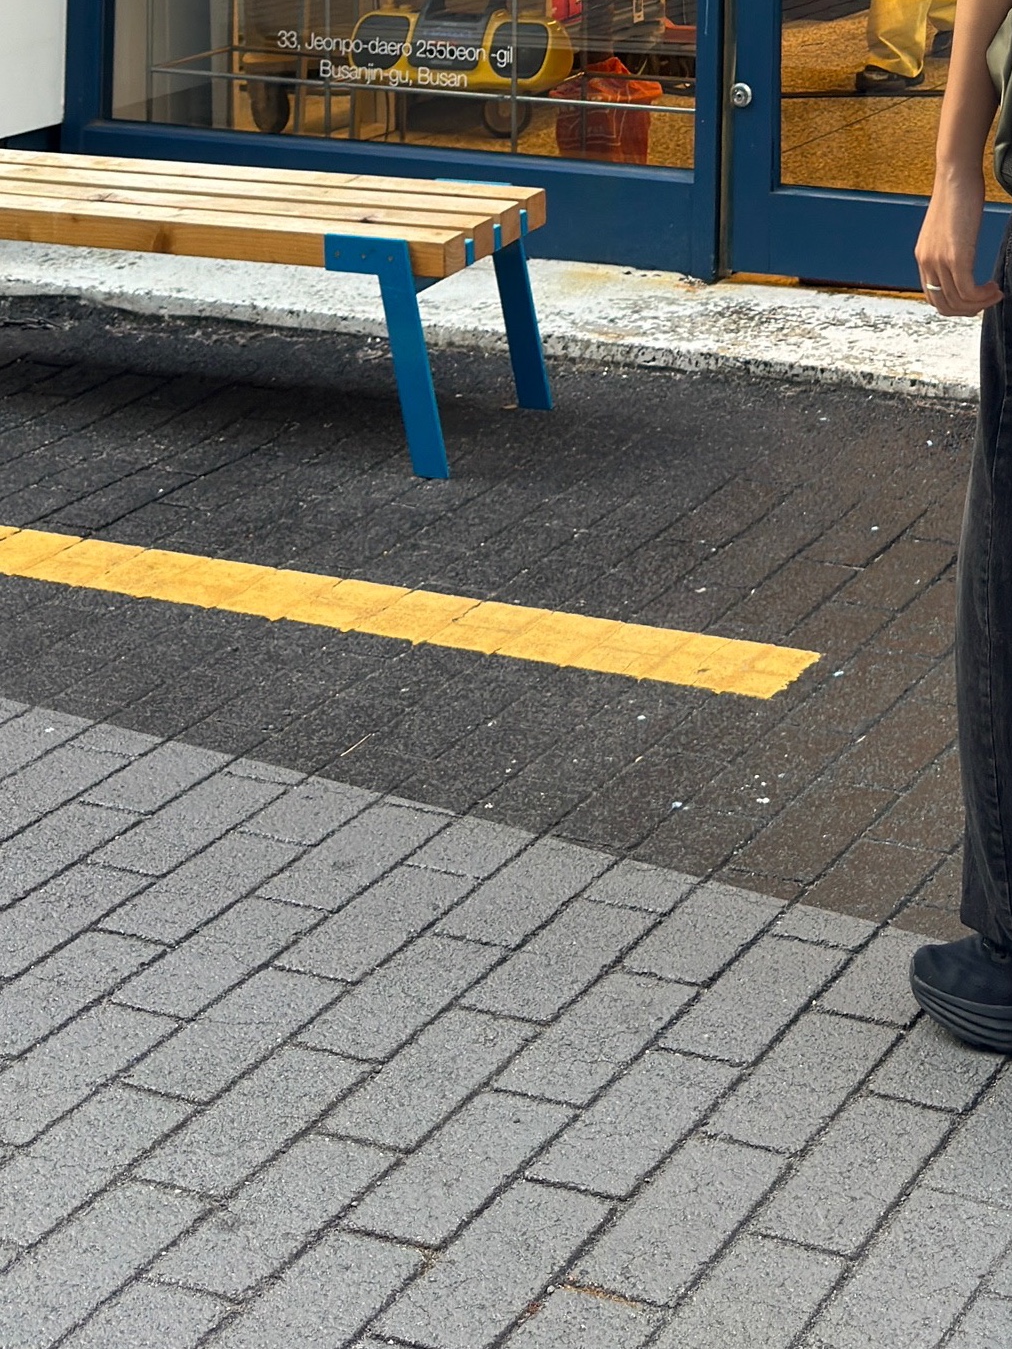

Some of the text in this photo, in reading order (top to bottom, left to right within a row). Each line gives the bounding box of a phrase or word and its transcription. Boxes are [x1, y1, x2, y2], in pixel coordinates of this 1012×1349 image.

[277, 29, 301, 51] 33,
[305, 32, 412, 58] Jeonpo-daero
[416, 39, 486, 62] 255beon
[319, 58, 468, 88] Busanjin-gu, Busan
